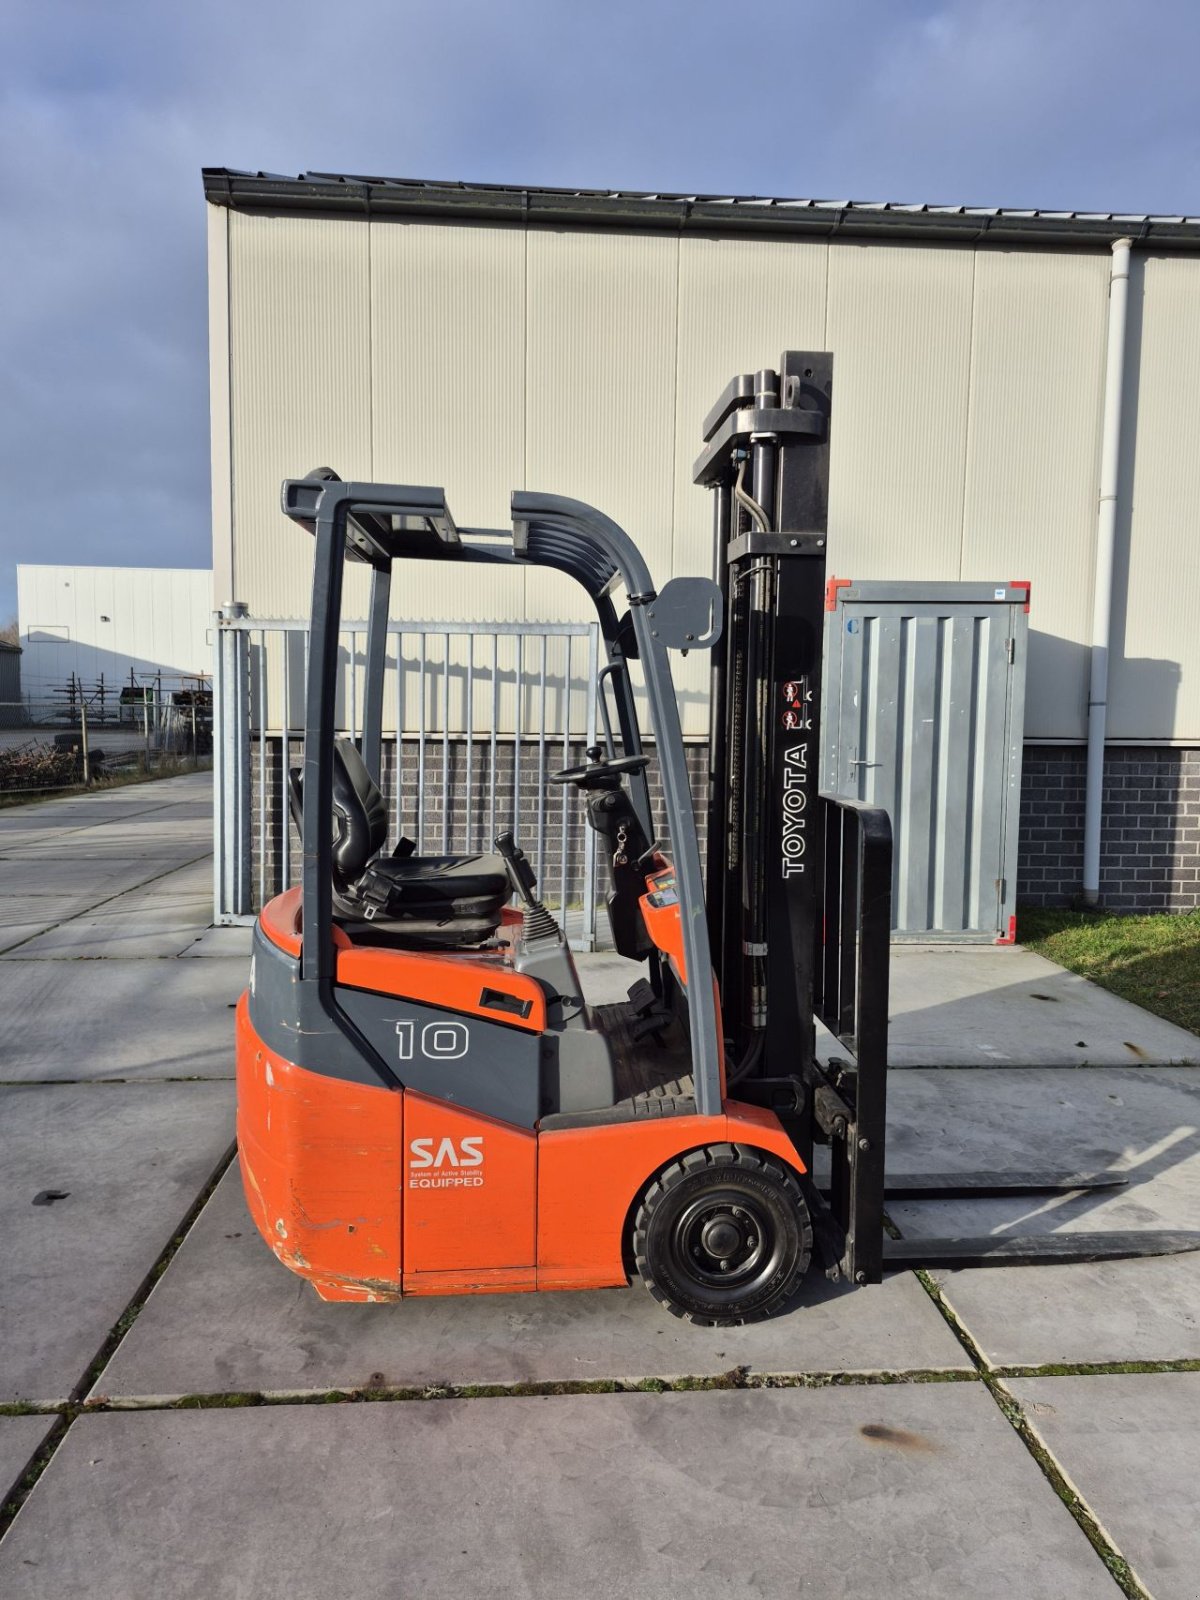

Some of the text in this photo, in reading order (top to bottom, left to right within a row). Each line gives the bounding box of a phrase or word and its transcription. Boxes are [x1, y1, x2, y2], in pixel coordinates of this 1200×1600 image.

[781, 743, 808, 879] TOYOTA
[395, 1021, 470, 1060] 10
[410, 1136, 484, 1169] SAS
[409, 1177, 484, 1189] EQUIPPED
[410, 1171, 432, 1179] System
[460, 1169, 483, 1177] Stability
